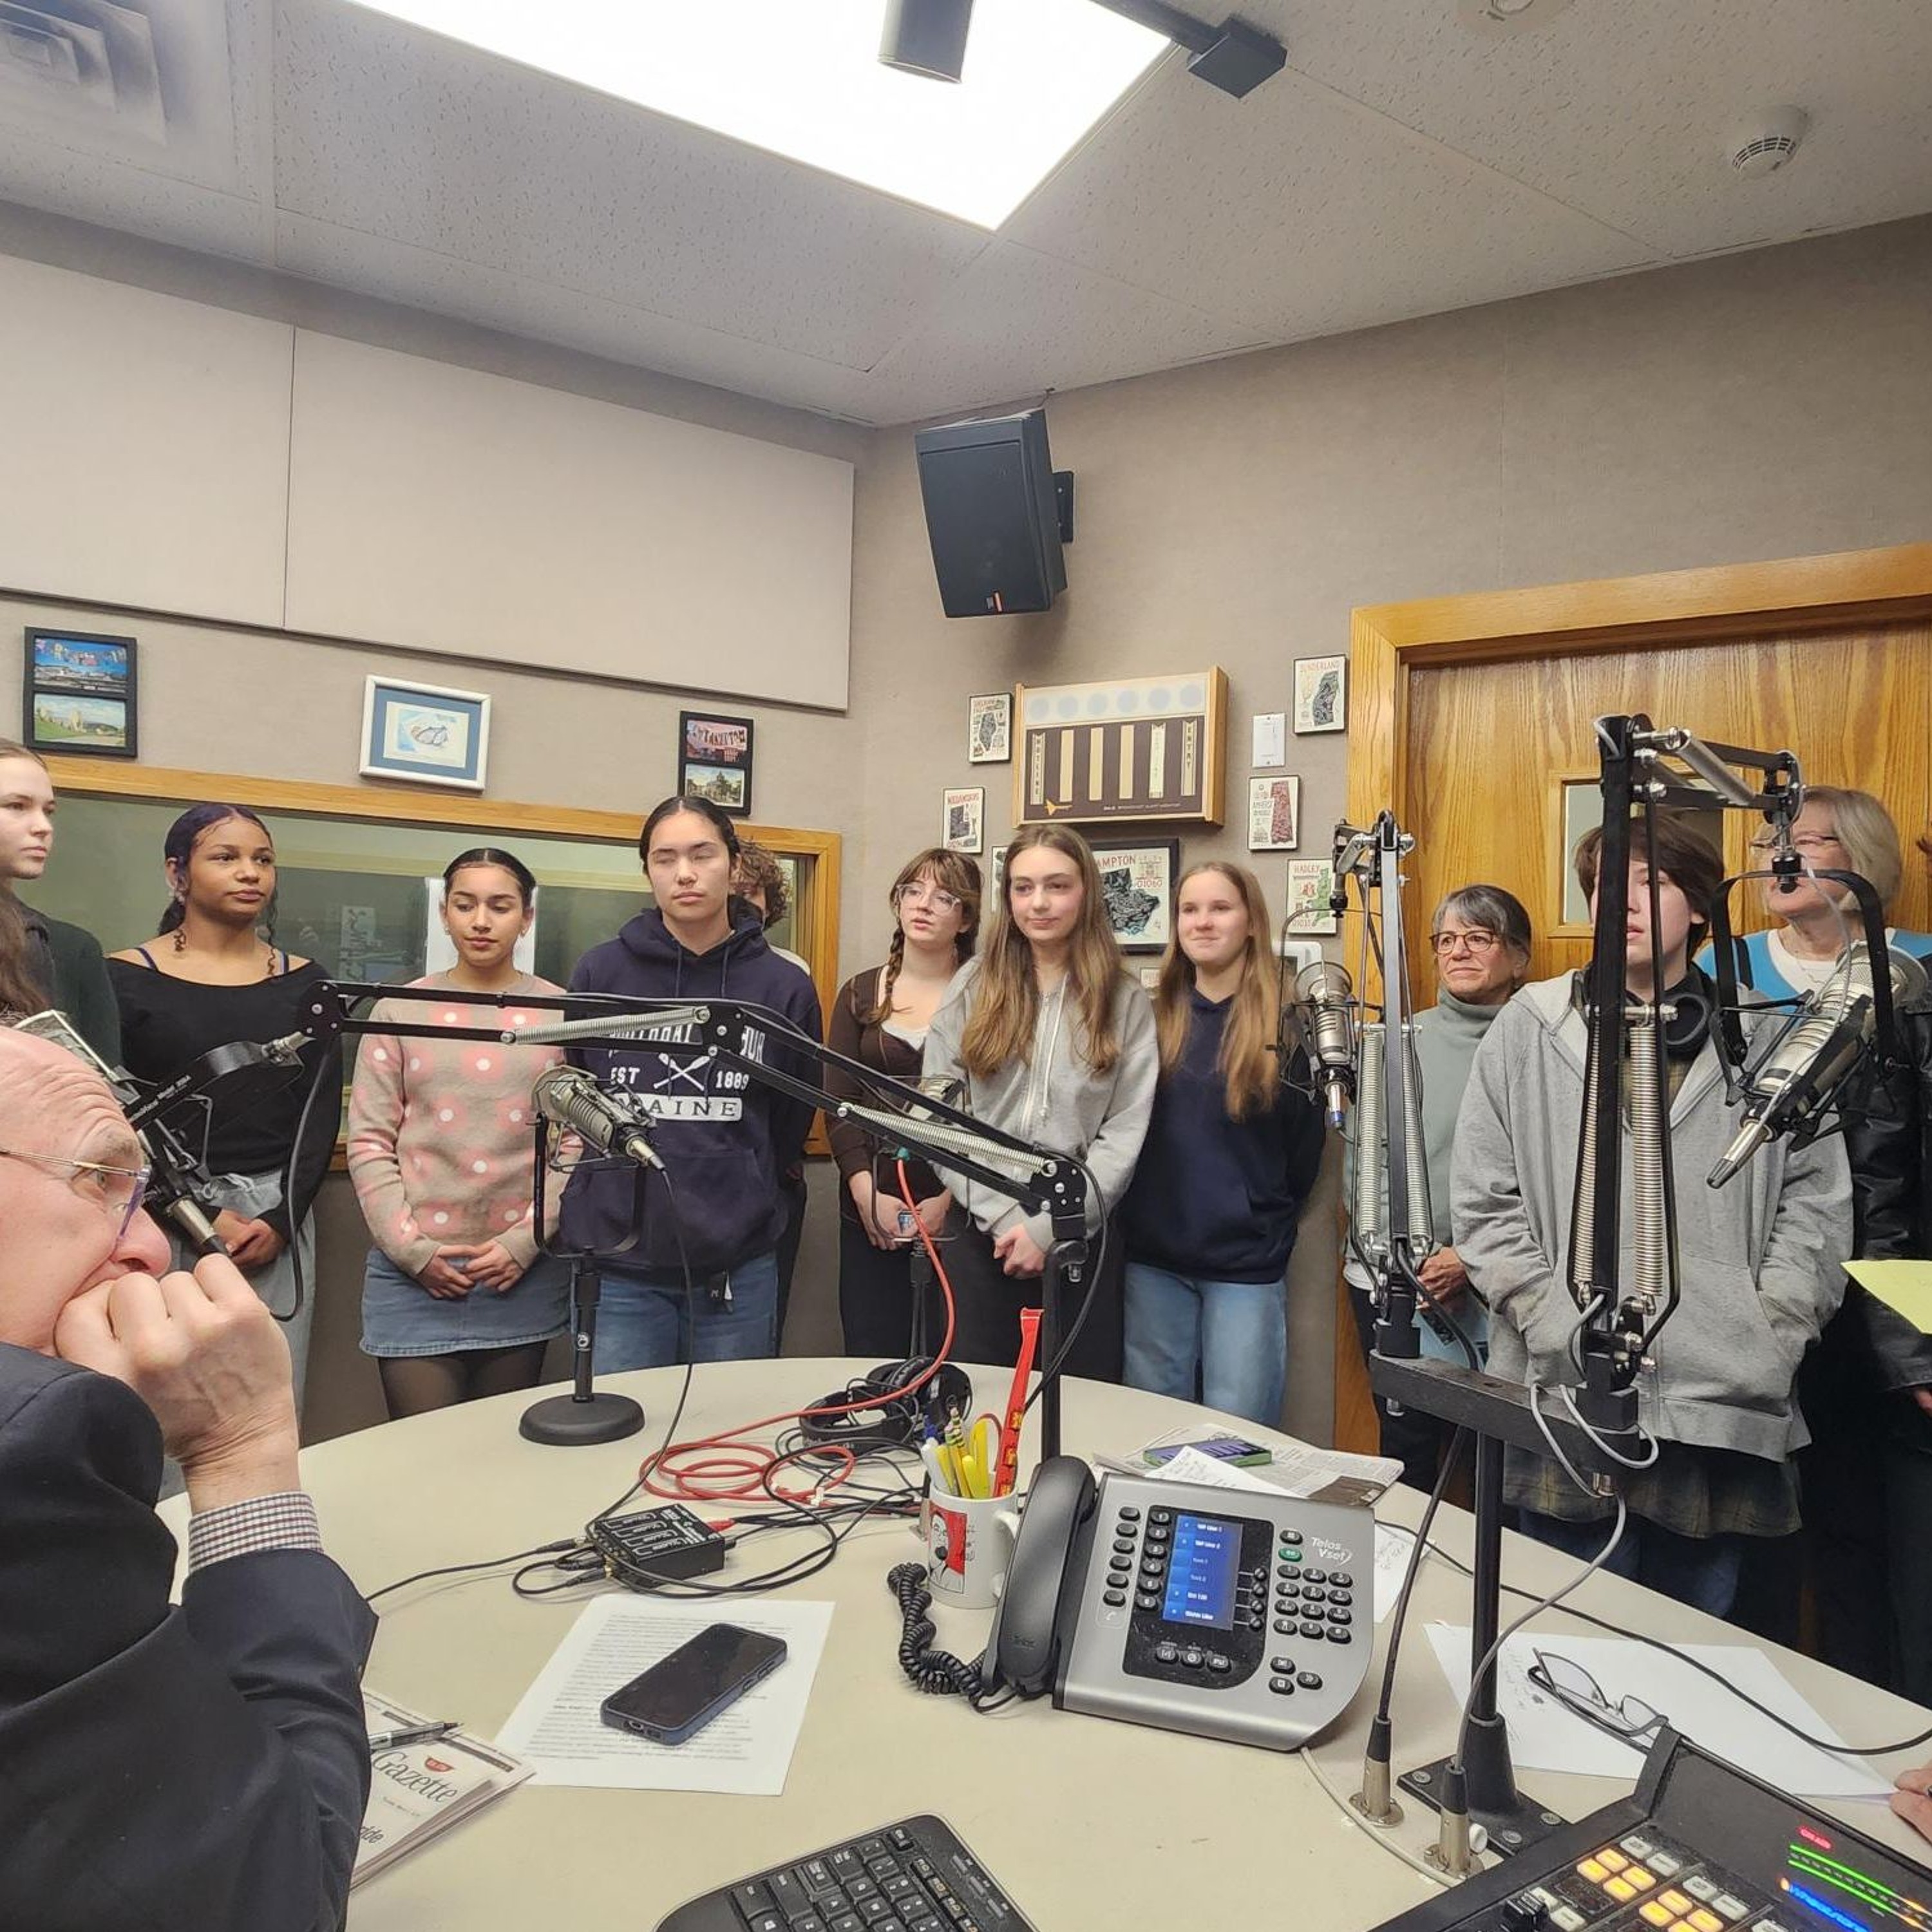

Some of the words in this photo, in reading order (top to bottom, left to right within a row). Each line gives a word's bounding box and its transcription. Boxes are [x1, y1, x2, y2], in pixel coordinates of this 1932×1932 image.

[1096, 855, 1136, 868] AMPTON
[715, 1070, 750, 1090] 1889
[648, 1099, 738, 1117] AINE
[1311, 1537, 1341, 1550] Telos
[372, 1751, 457, 1802] Gazette
